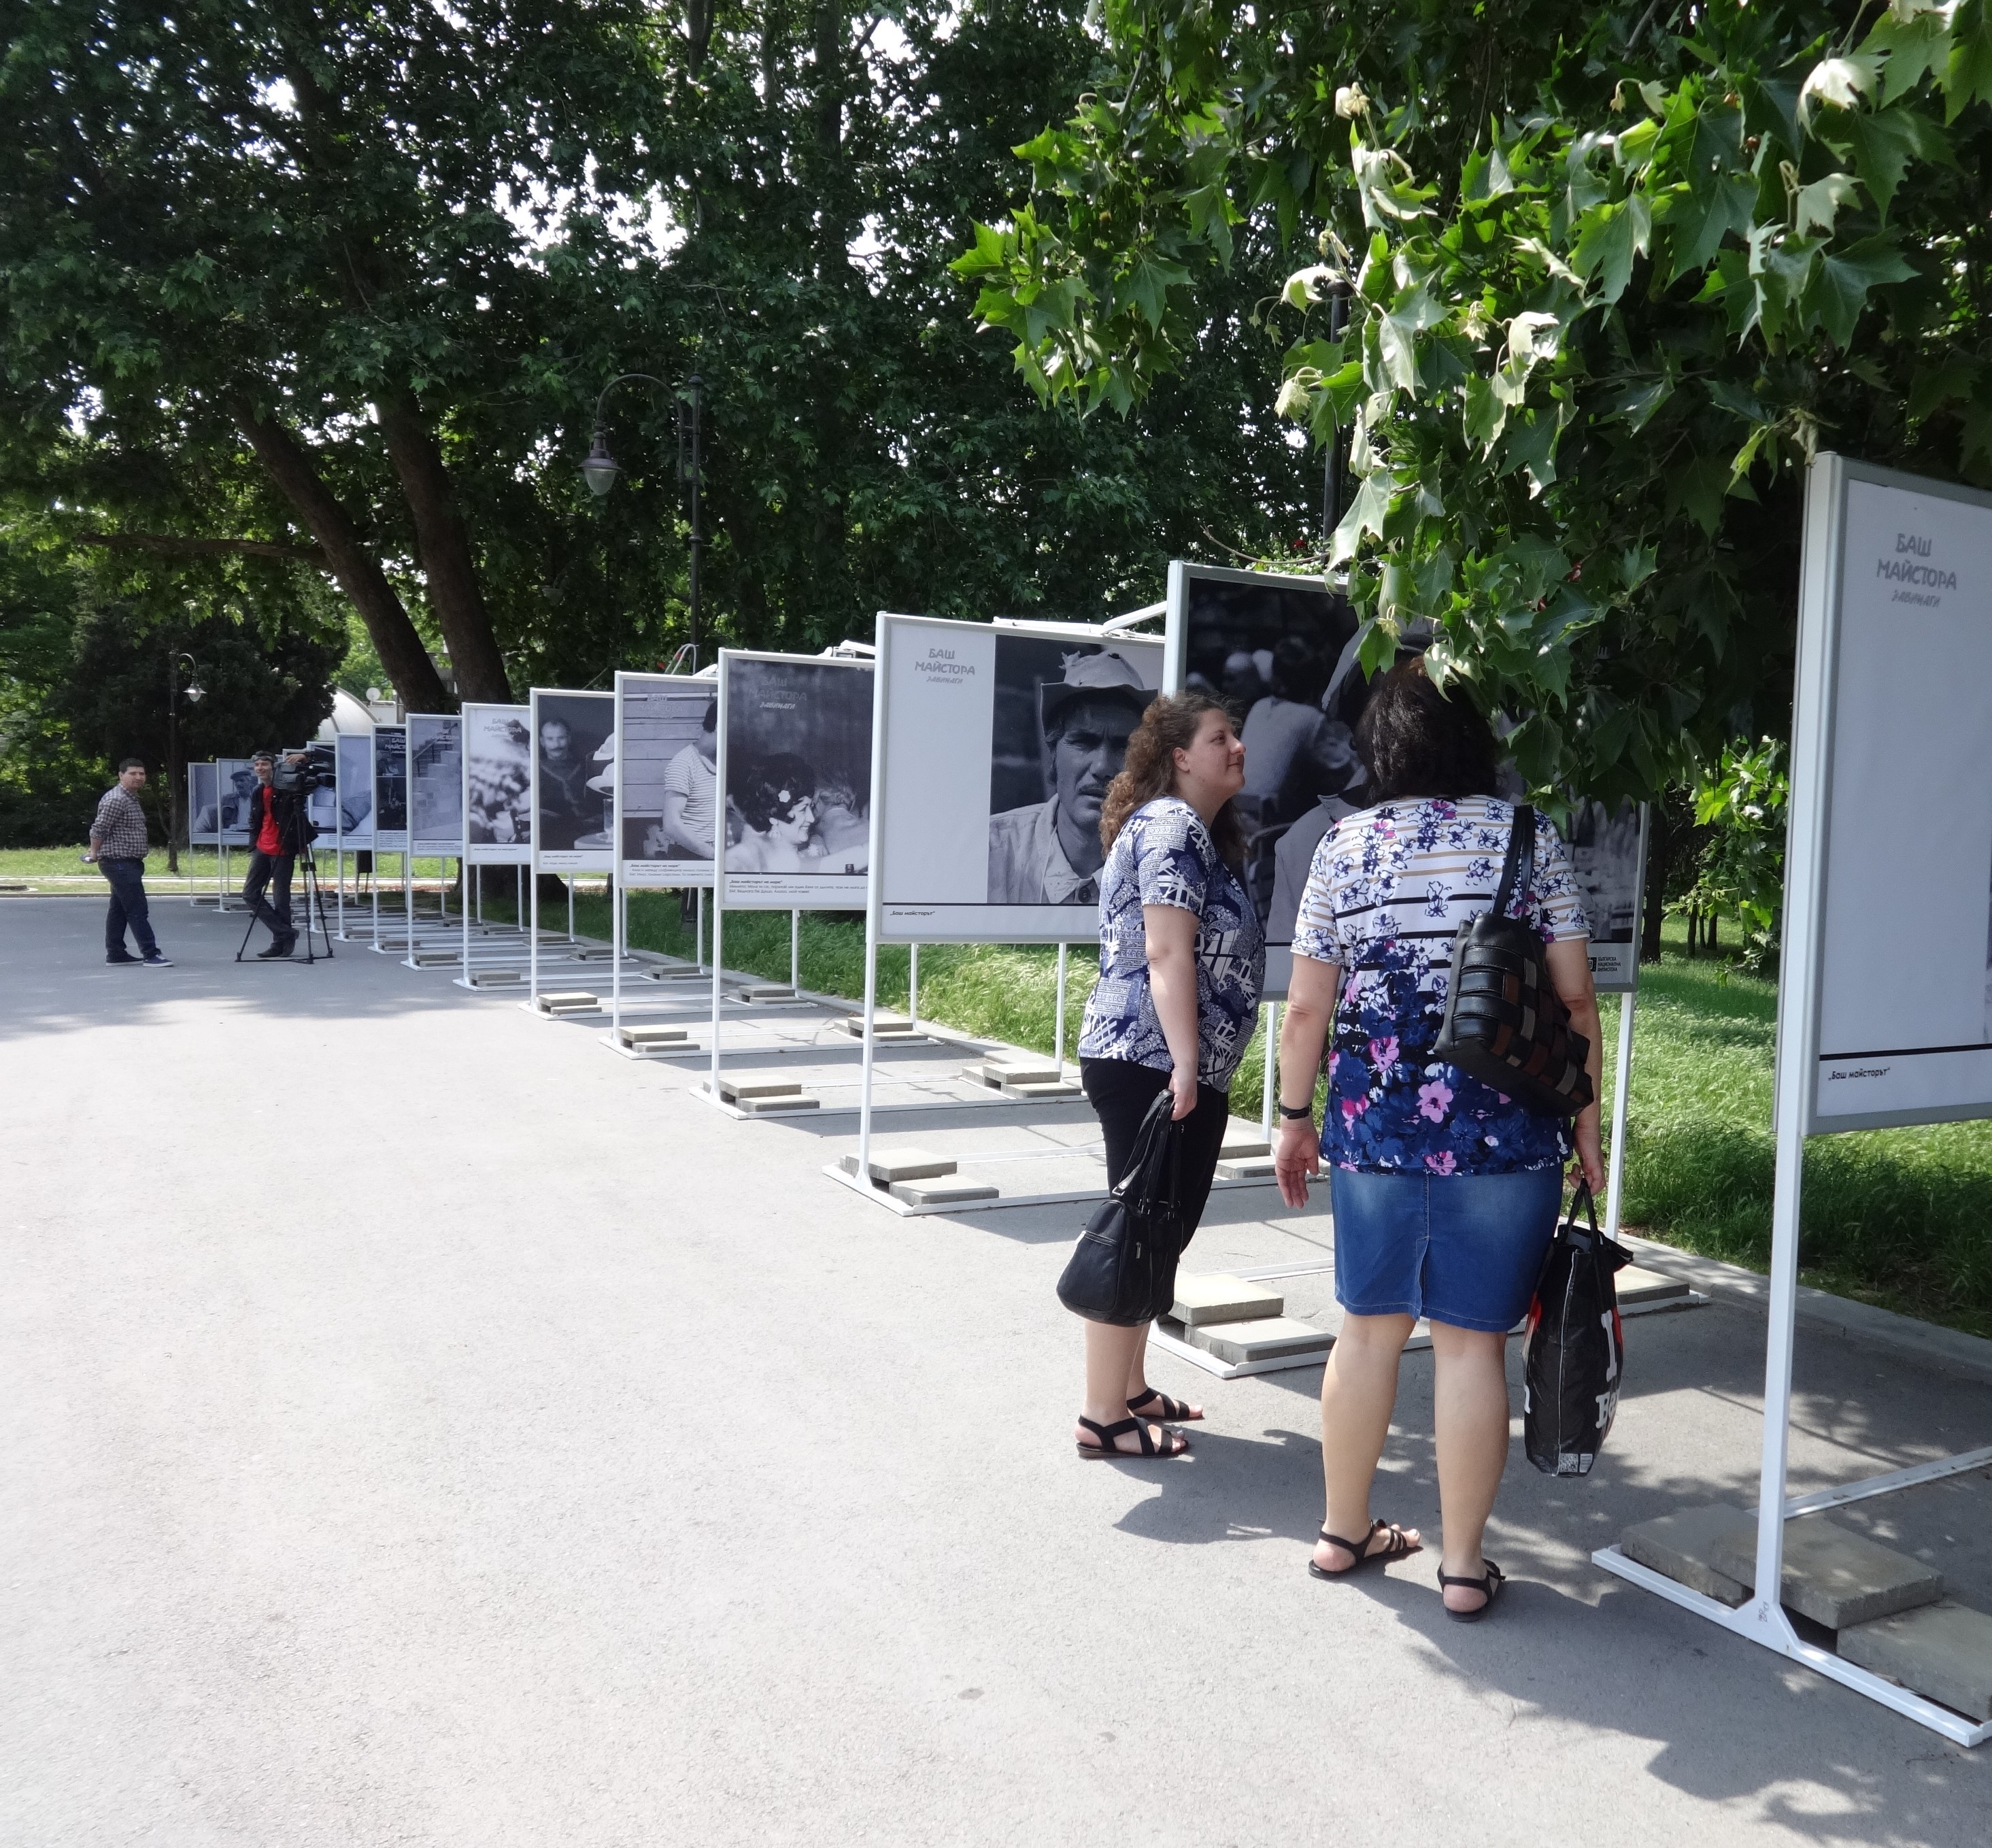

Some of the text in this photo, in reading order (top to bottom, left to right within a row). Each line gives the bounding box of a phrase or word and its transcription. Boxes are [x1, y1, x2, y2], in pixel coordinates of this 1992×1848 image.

[1895, 533, 1932, 557] БАШ
[1876, 558, 1957, 590] МАЙСТОРА
[928, 648, 955, 659] БАШ
[915, 660, 975, 675] МАЙСТОРА
